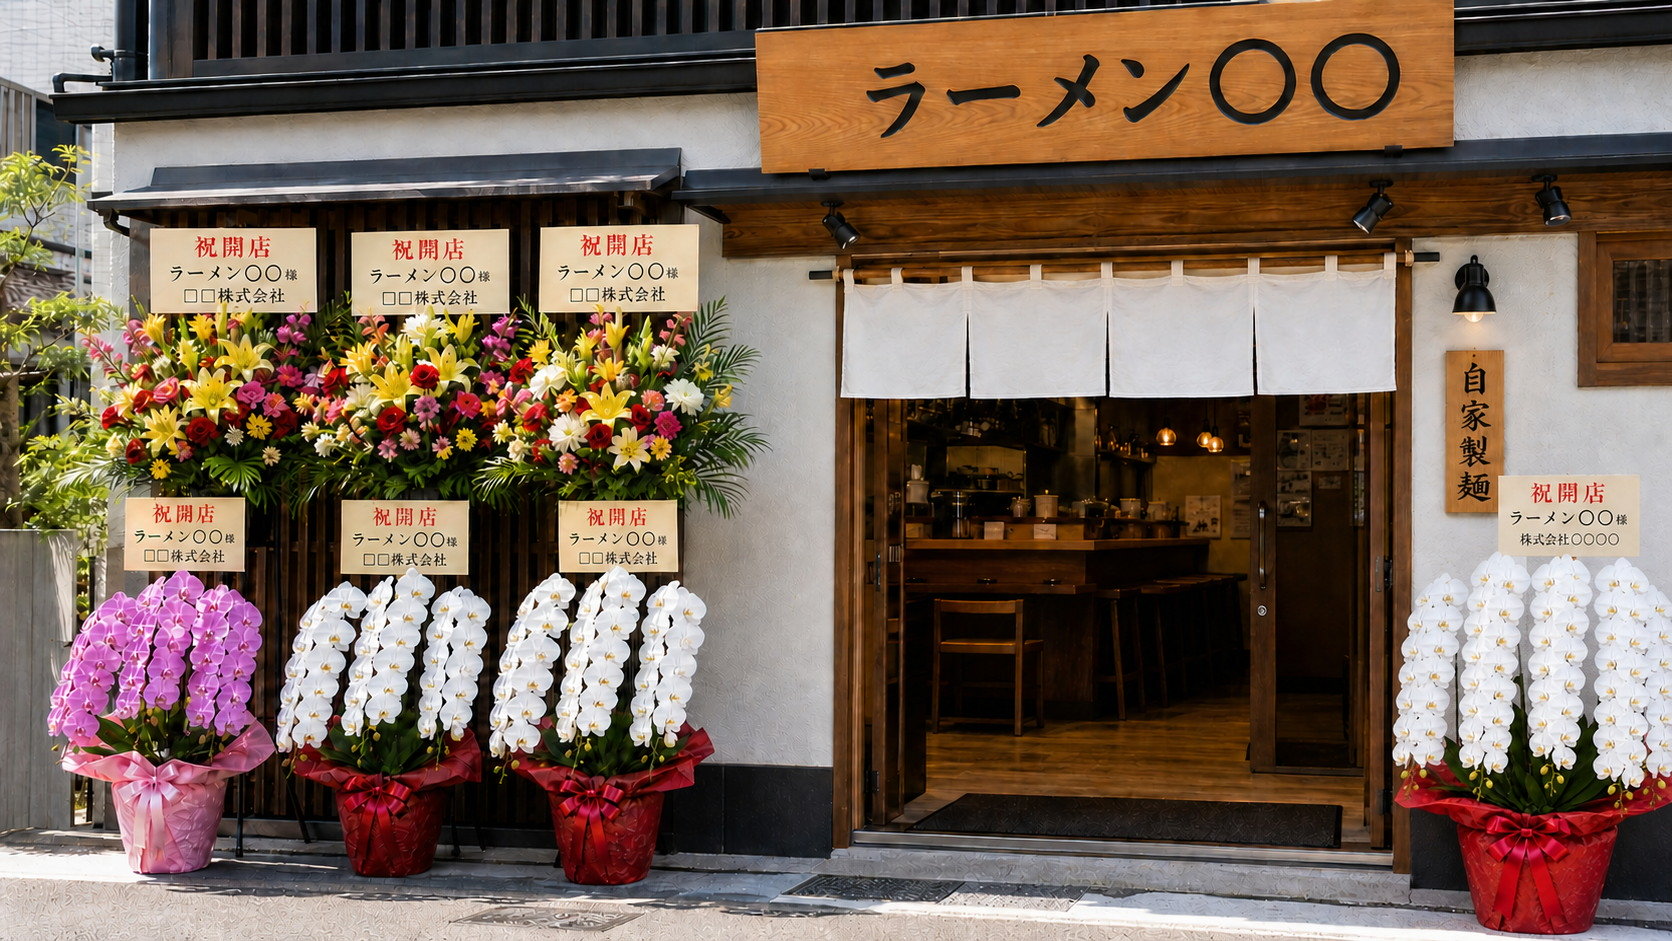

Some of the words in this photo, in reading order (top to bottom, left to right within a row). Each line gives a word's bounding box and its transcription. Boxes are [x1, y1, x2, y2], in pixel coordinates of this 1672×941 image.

[194, 235, 271, 258] 祝開店
[391, 238, 465, 261] 祝開店
[580, 233, 654, 257] 祝開店
[1457, 362, 1492, 502] 自家製麺
[1530, 481, 1606, 504] 祝開店
[152, 503, 216, 524] 祝開店
[373, 506, 438, 527] 祝開店
[586, 506, 648, 527] 祝開店
